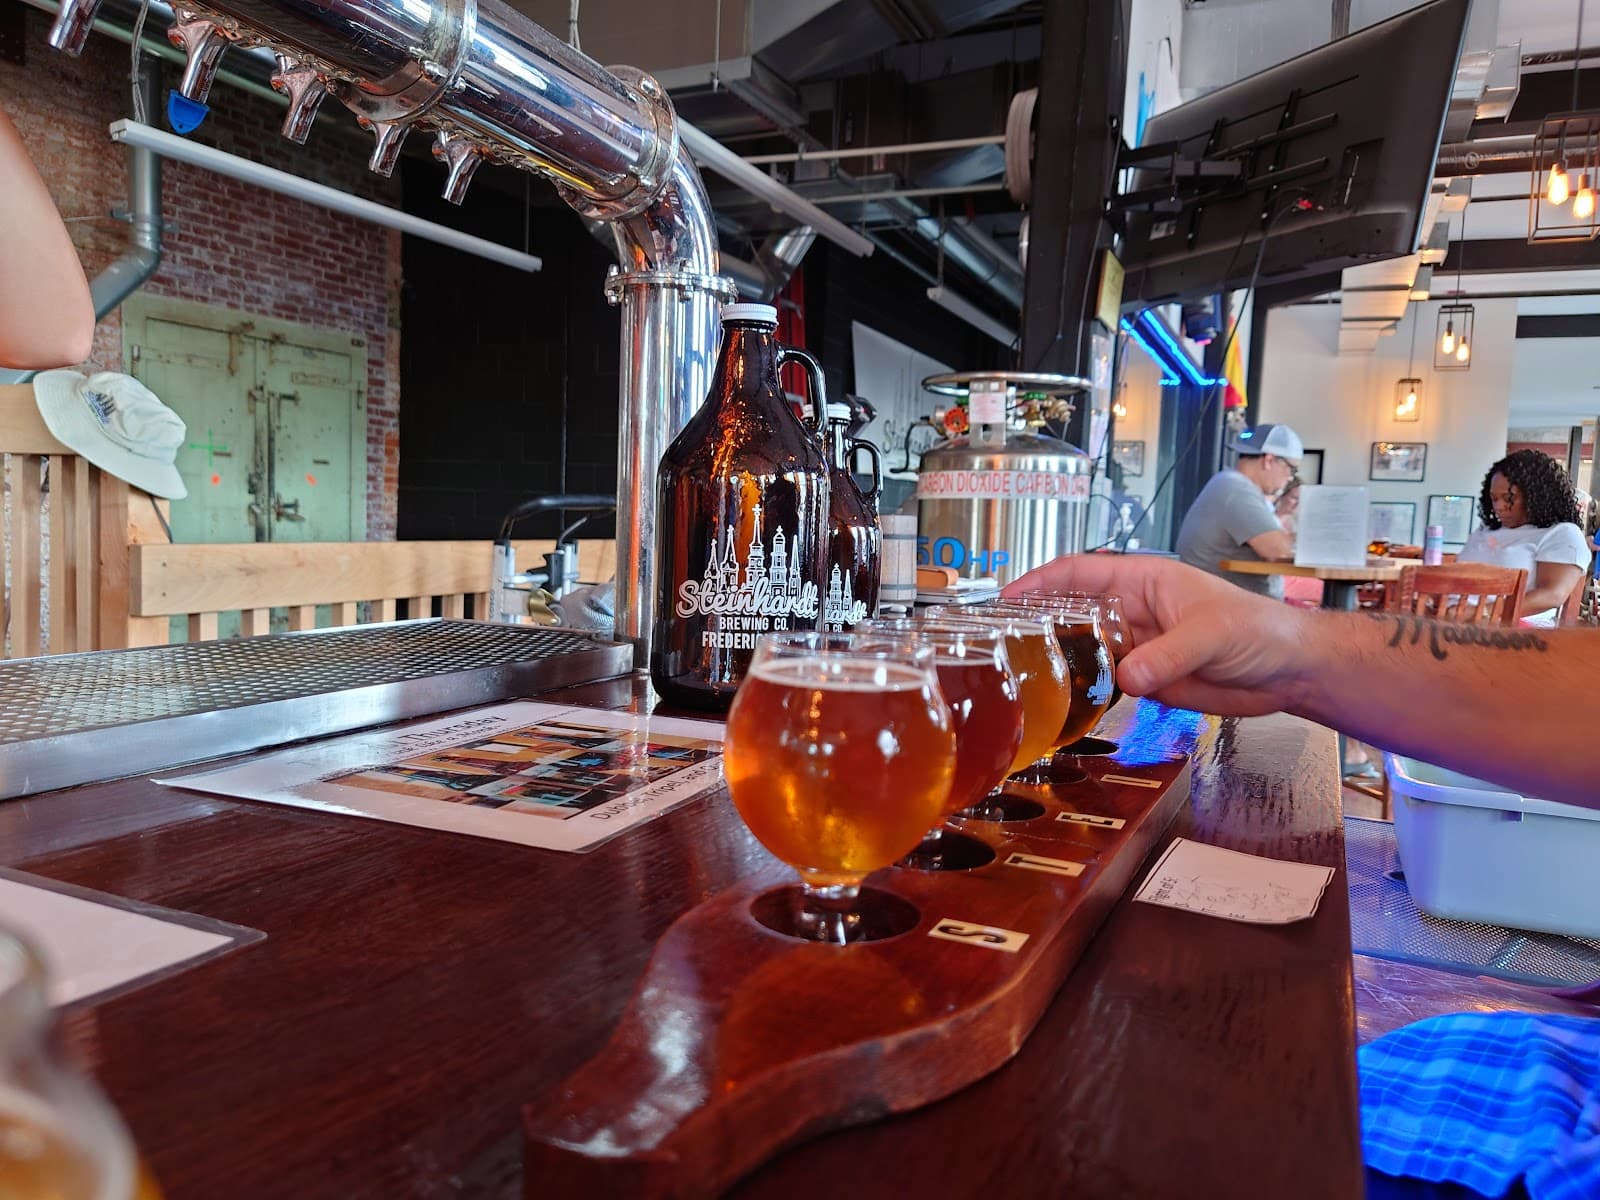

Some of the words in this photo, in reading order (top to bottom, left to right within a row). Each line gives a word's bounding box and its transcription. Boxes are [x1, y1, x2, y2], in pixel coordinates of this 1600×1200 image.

[957, 471, 1010, 493] DIOXIDE
[676, 577, 819, 619] Steinhardt
[719, 616, 769, 631] BREWING
[774, 617, 789, 631] CO.
[1368, 609, 1548, 661] Madison
[399, 715, 508, 742] Thursday
